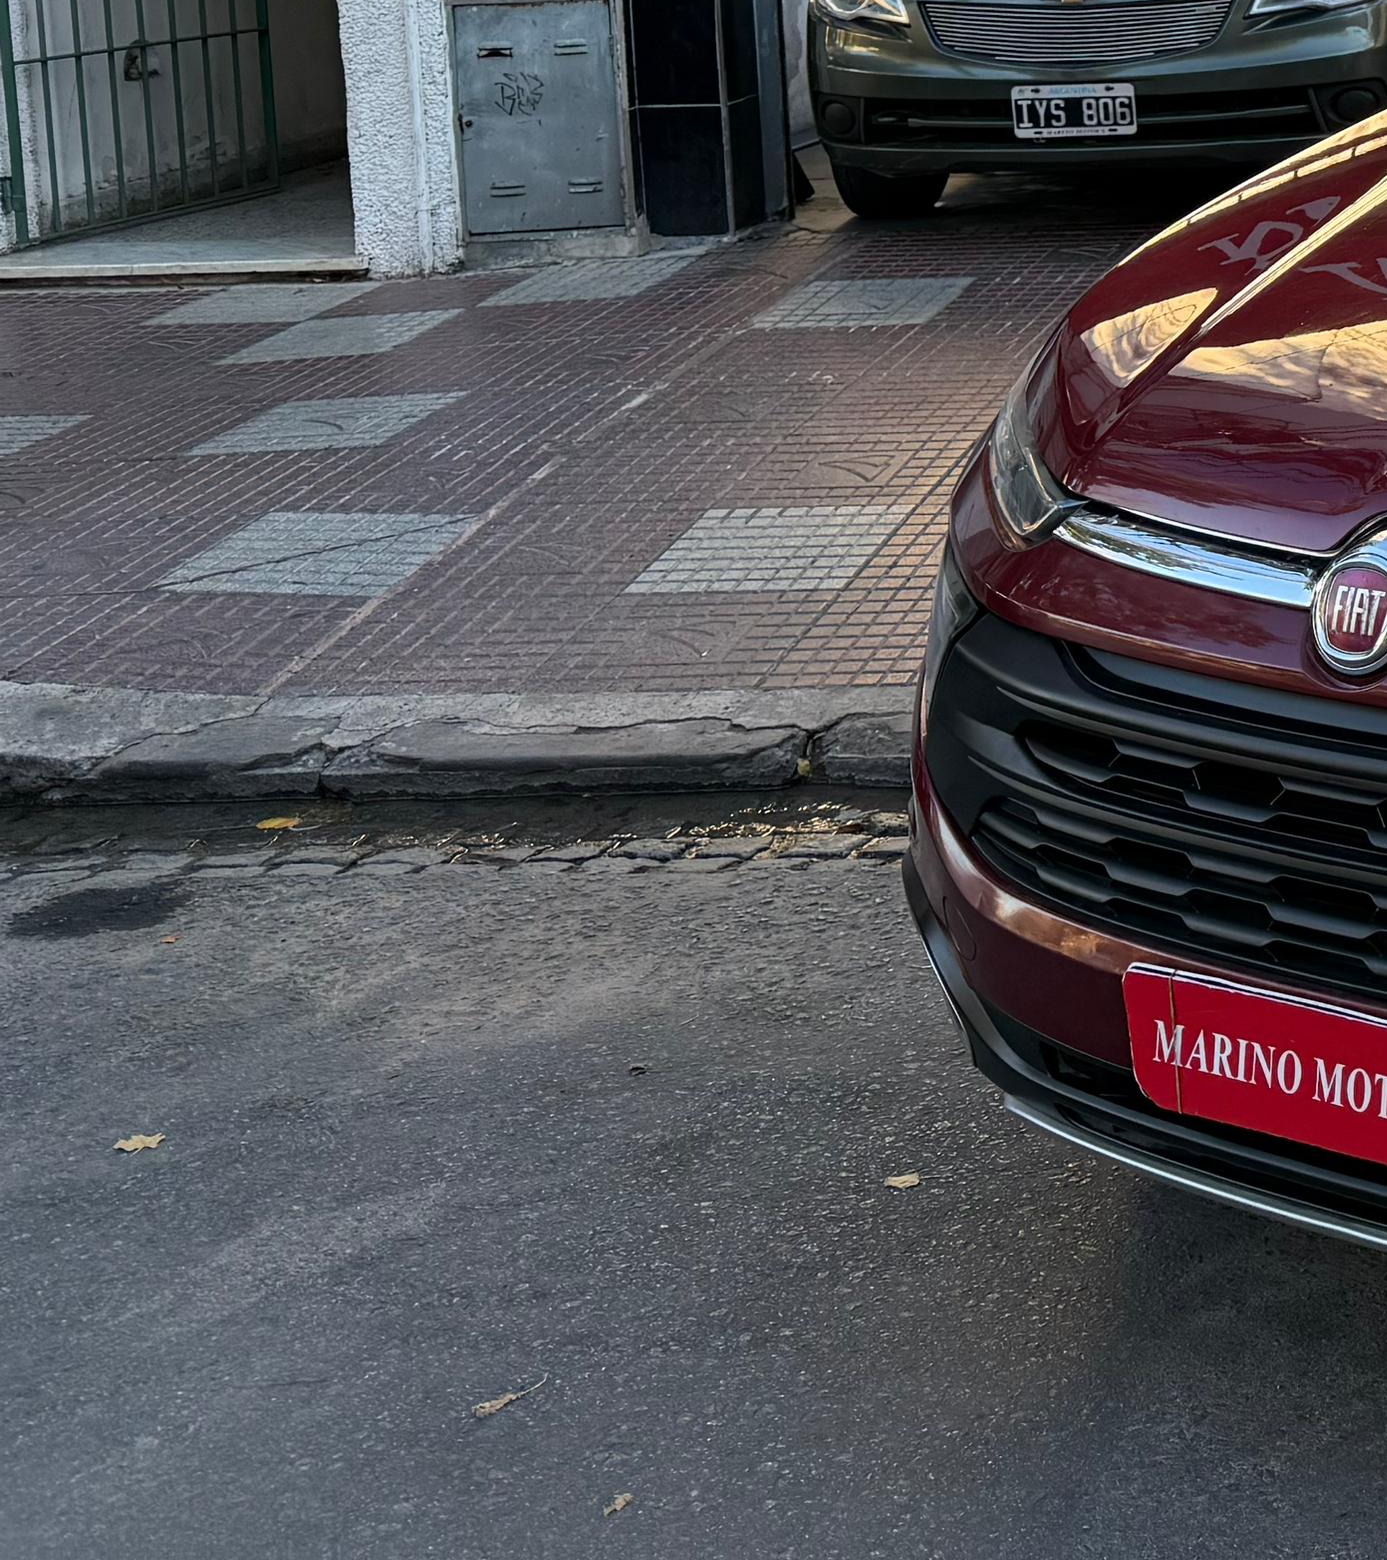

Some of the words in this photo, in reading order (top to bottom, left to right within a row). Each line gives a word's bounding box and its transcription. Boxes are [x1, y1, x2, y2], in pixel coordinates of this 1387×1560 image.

[1017, 99, 1066, 128] IYS
[1082, 97, 1131, 126] 806
[1331, 585, 1387, 637] FIAT
[1152, 1019, 1303, 1095] MARINO
